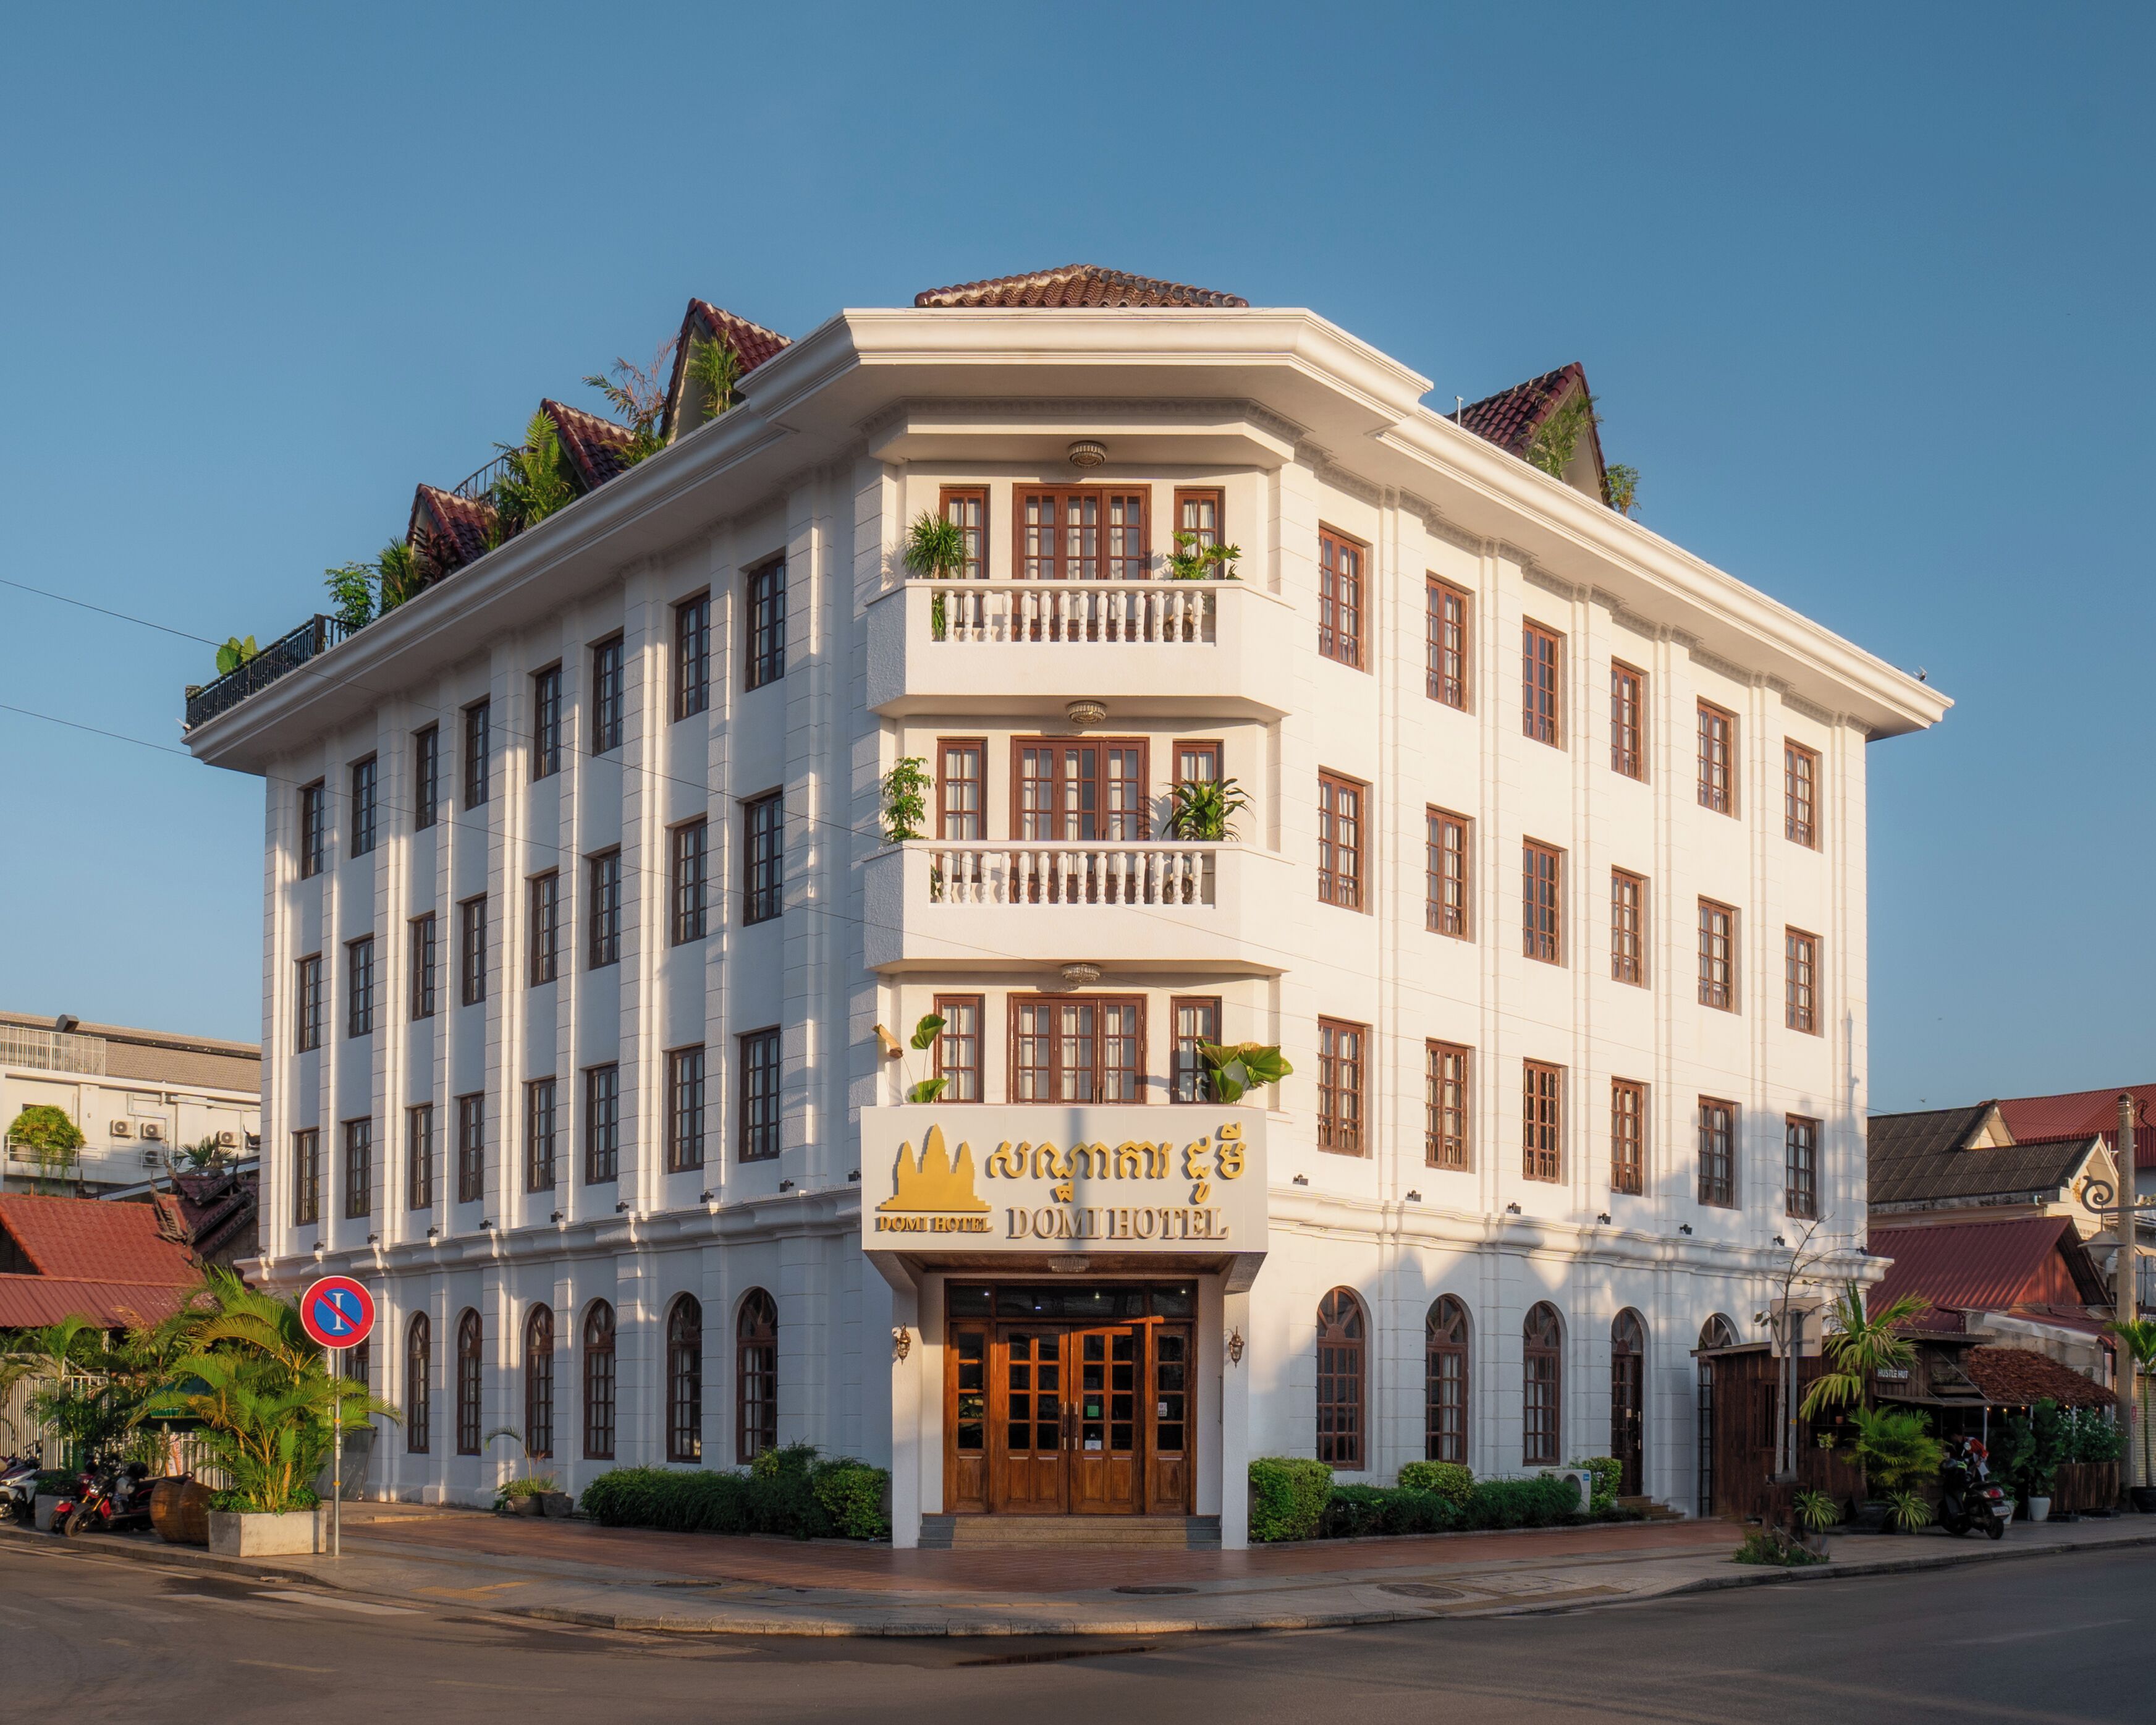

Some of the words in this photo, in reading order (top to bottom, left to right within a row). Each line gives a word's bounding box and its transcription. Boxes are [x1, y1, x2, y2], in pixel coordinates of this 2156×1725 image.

[990, 1140, 1173, 1203] សណ្ឋាគារ
[879, 1216, 929, 1232] DOMI
[932, 1216, 993, 1232] HOTEL
[1008, 1206, 1104, 1239] DOMI
[1110, 1207, 1230, 1239] HOTEL
[1877, 1368, 1898, 1378] HUSTLE
[1898, 1370, 1909, 1379] HUT
